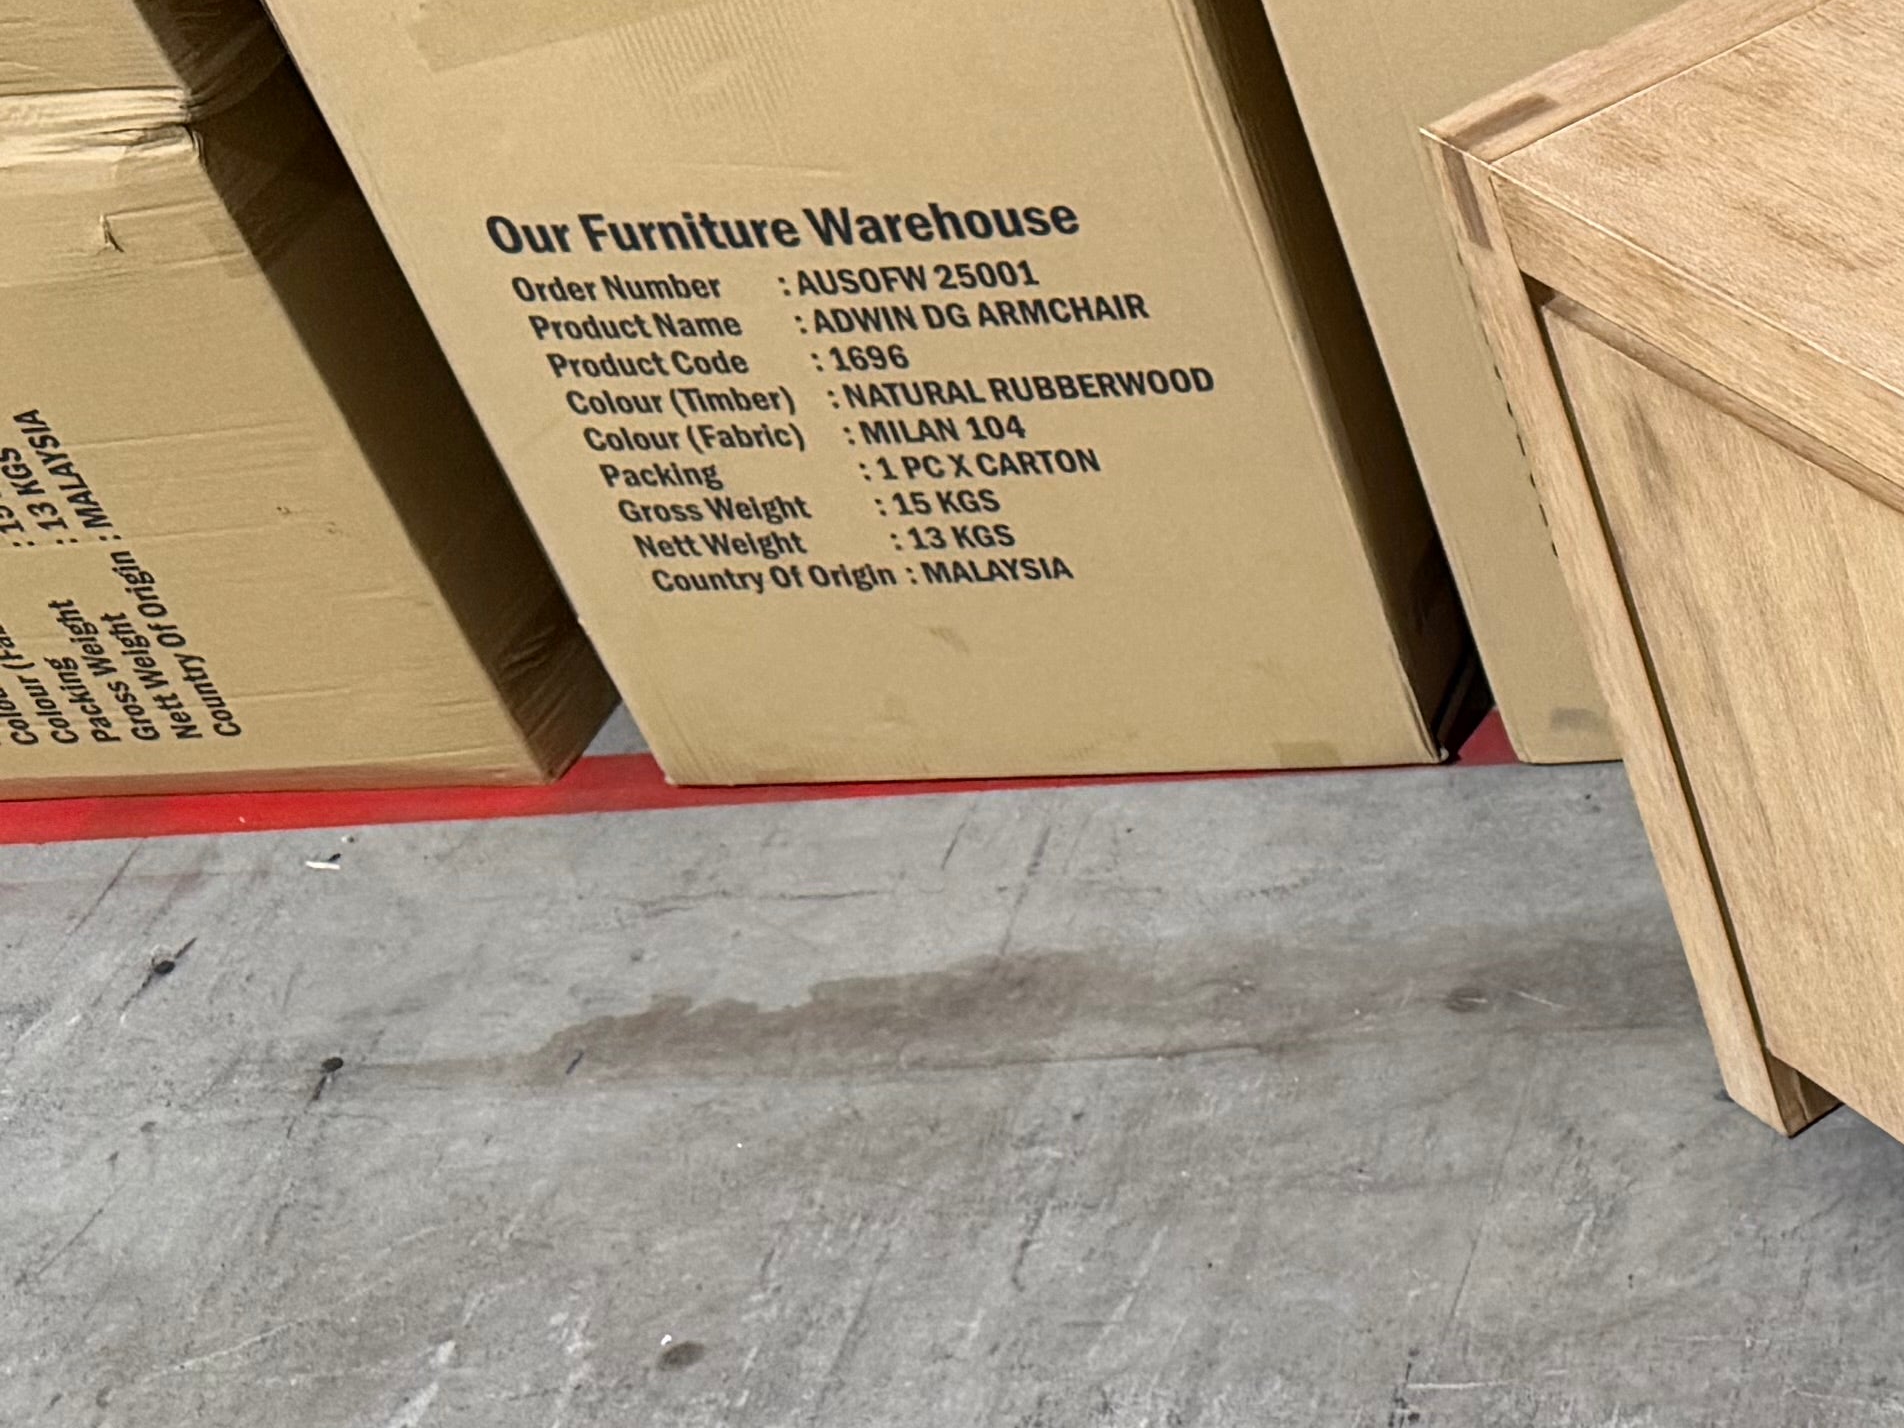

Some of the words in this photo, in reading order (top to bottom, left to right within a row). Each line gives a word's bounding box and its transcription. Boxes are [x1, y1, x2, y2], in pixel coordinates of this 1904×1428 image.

[485, 215, 572, 255] Our
[577, 211, 802, 253] Furniture
[801, 202, 1080, 247] Warehouse
[511, 275, 597, 303] Order
[599, 273, 721, 301] Number
[796, 264, 928, 296] AUSOFW
[932, 259, 1040, 290] 25001
[527, 313, 653, 341] Product
[651, 312, 743, 338] Name
[813, 304, 919, 334] ADWIN
[920, 302, 972, 330] DG
[977, 293, 1151, 328] ARMCHAIR
[565, 389, 663, 416] Colour
[669, 385, 796, 419] (Timber)
[841, 378, 987, 409] NATURAL
[986, 367, 1215, 403] RUBBERWOOD
[582, 426, 680, 452] Colour
[686, 422, 806, 455] (Fabric)
[858, 417, 961, 445] MILAN
[965, 414, 1026, 441] 104
[0, 447, 46, 496] KGS
[12, 408, 114, 530] MALAYSIA
[26, 502, 69, 531] 13
[110, 550, 169, 620] Origin
[651, 567, 765, 595] Country
[768, 564, 804, 589] Of
[807, 563, 898, 592] Origin
[919, 556, 1075, 585] MALAYSIA
[48, 598, 118, 677] Weight
[100, 610, 170, 690] Weight
[147, 623, 187, 649] Of
[17, 674, 80, 745] Colour
[43, 655, 122, 743] Packing
[107, 680, 161, 742] Gross
[153, 691, 204, 740] Nett
[174, 652, 242, 738] Country
